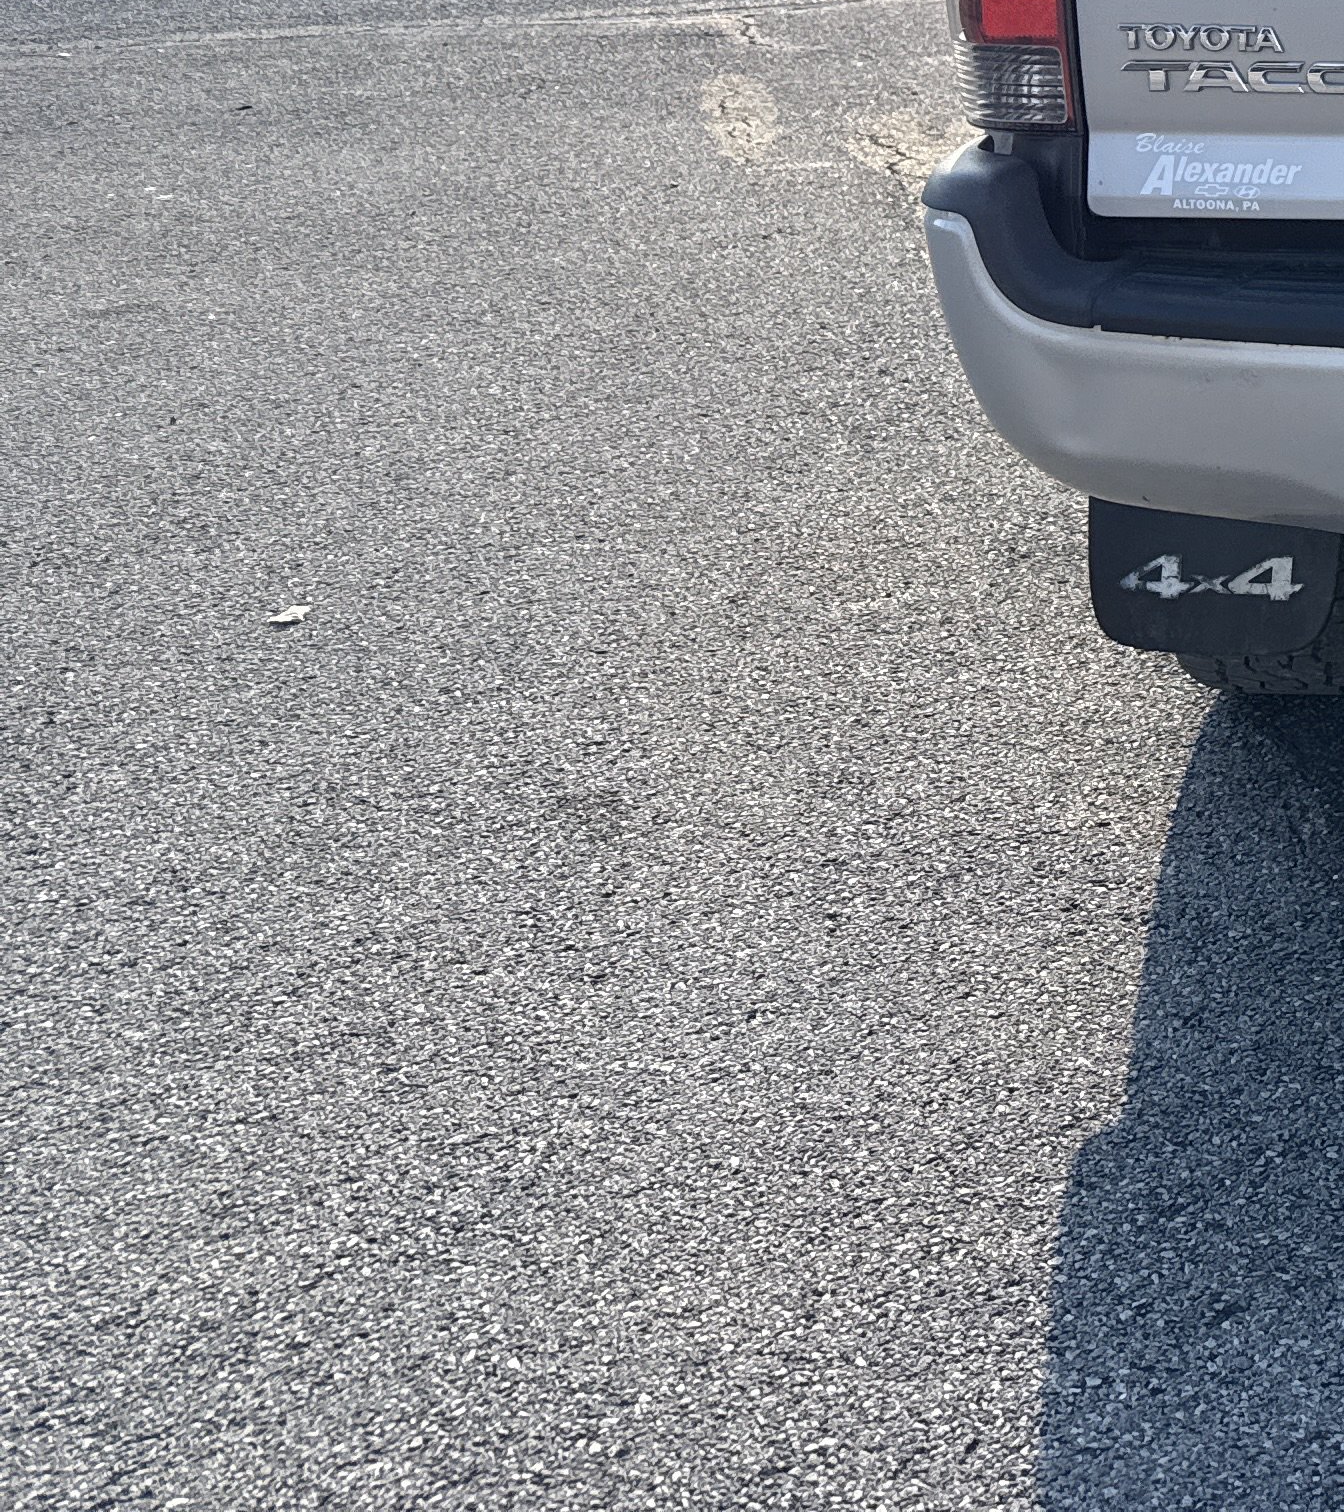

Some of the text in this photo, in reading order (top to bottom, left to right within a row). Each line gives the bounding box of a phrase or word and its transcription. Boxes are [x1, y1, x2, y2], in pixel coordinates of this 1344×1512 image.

[1117, 23, 1285, 53] TOYOTA
[1136, 132, 1205, 154] Blaise
[1140, 155, 1302, 195] Alexander
[1173, 199, 1260, 212] ALTOONA, PA
